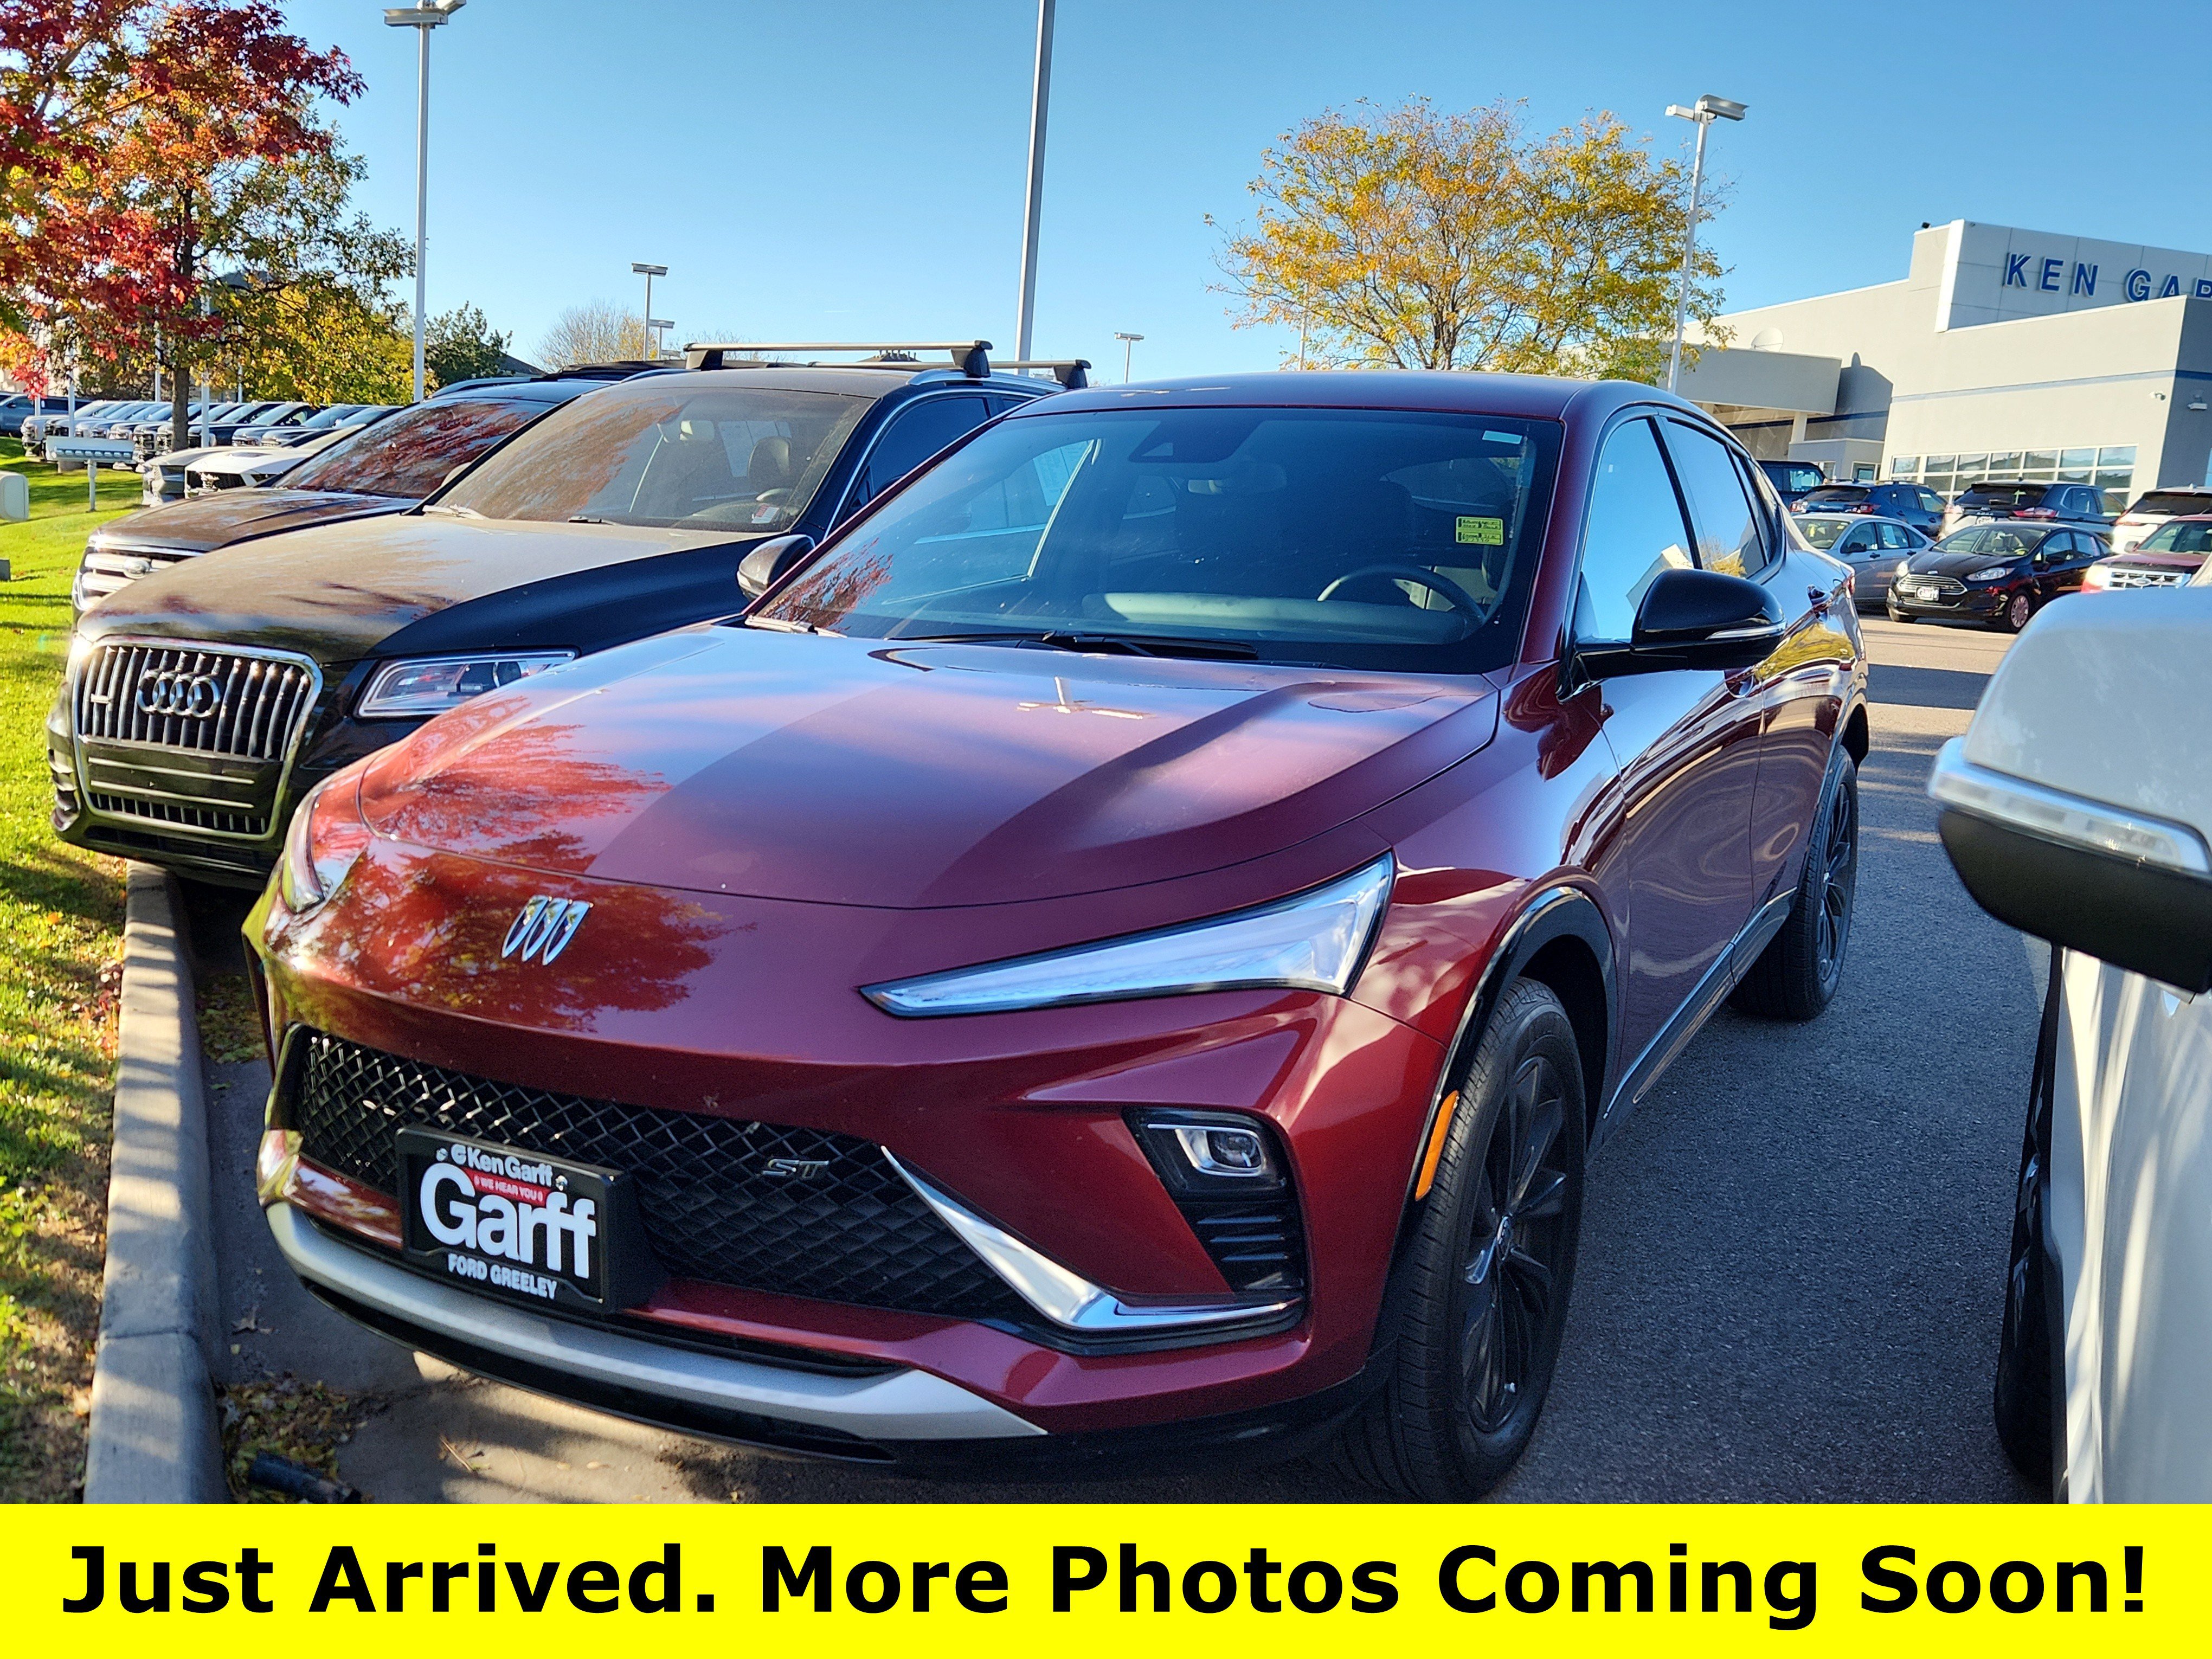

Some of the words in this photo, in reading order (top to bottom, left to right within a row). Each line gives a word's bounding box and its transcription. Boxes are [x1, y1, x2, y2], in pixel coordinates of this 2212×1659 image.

[2003, 252, 2099, 298] KEN
[762, 1158, 829, 1180] ST
[420, 1162, 596, 1279] Garff
[448, 1253, 488, 1281] FORD
[489, 1264, 558, 1300] GREELEY
